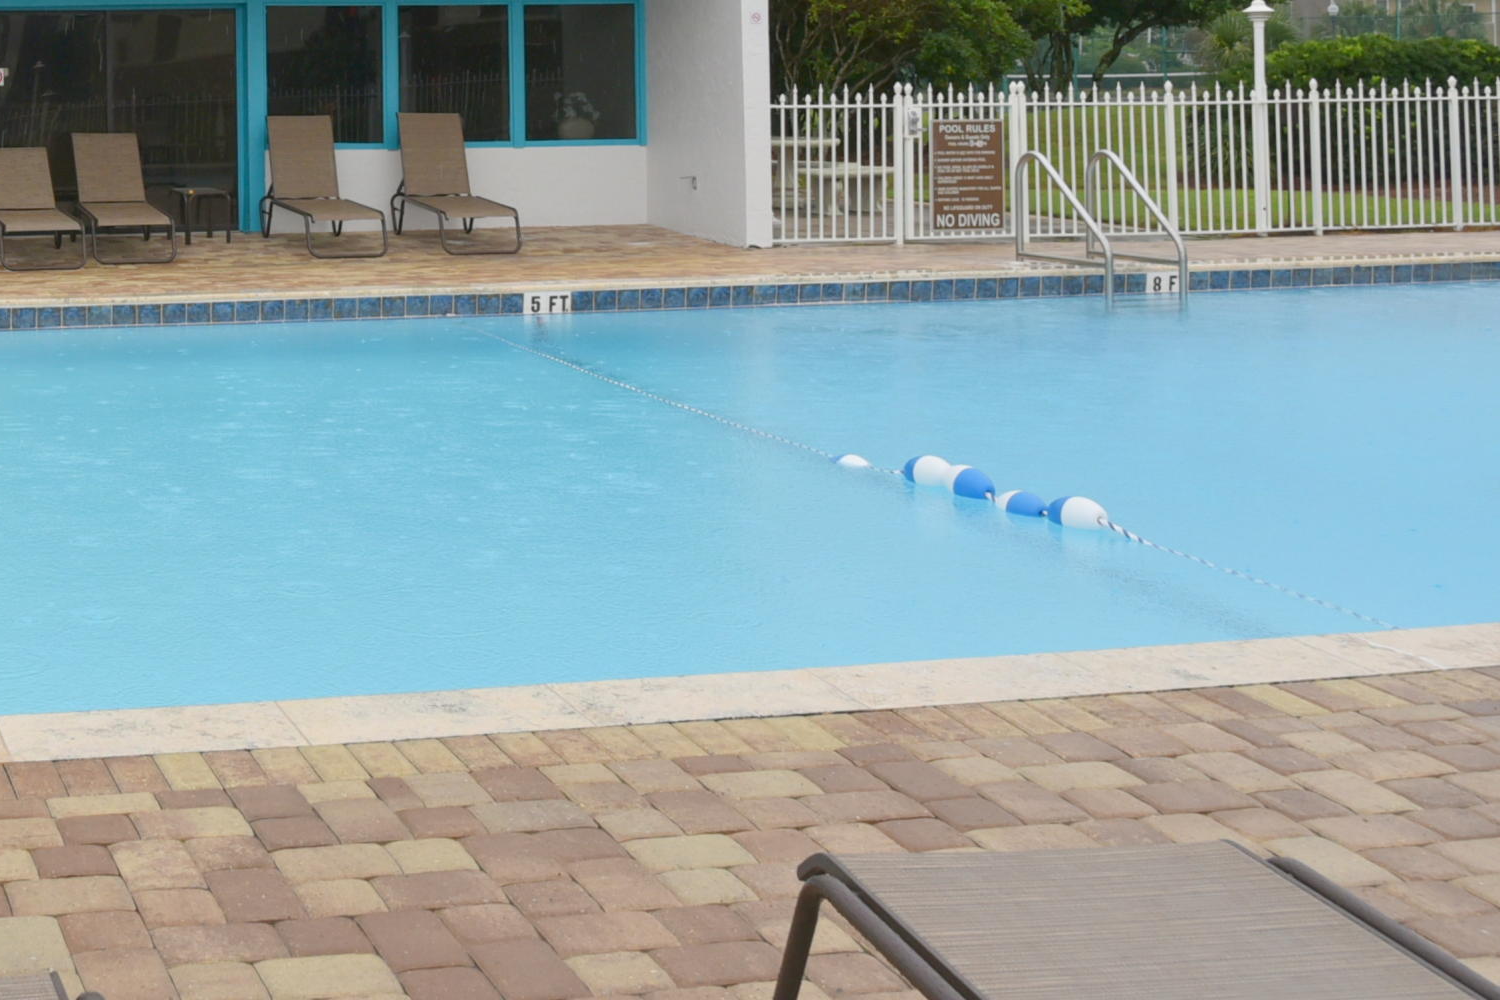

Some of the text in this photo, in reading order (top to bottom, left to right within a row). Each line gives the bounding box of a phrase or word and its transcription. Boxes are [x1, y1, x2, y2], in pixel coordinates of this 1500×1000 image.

[939, 124, 996, 133] POOL RULES
[936, 213, 1000, 227] NO DIVING
[1153, 276, 1162, 291] 8
[531, 296, 541, 313] 5
